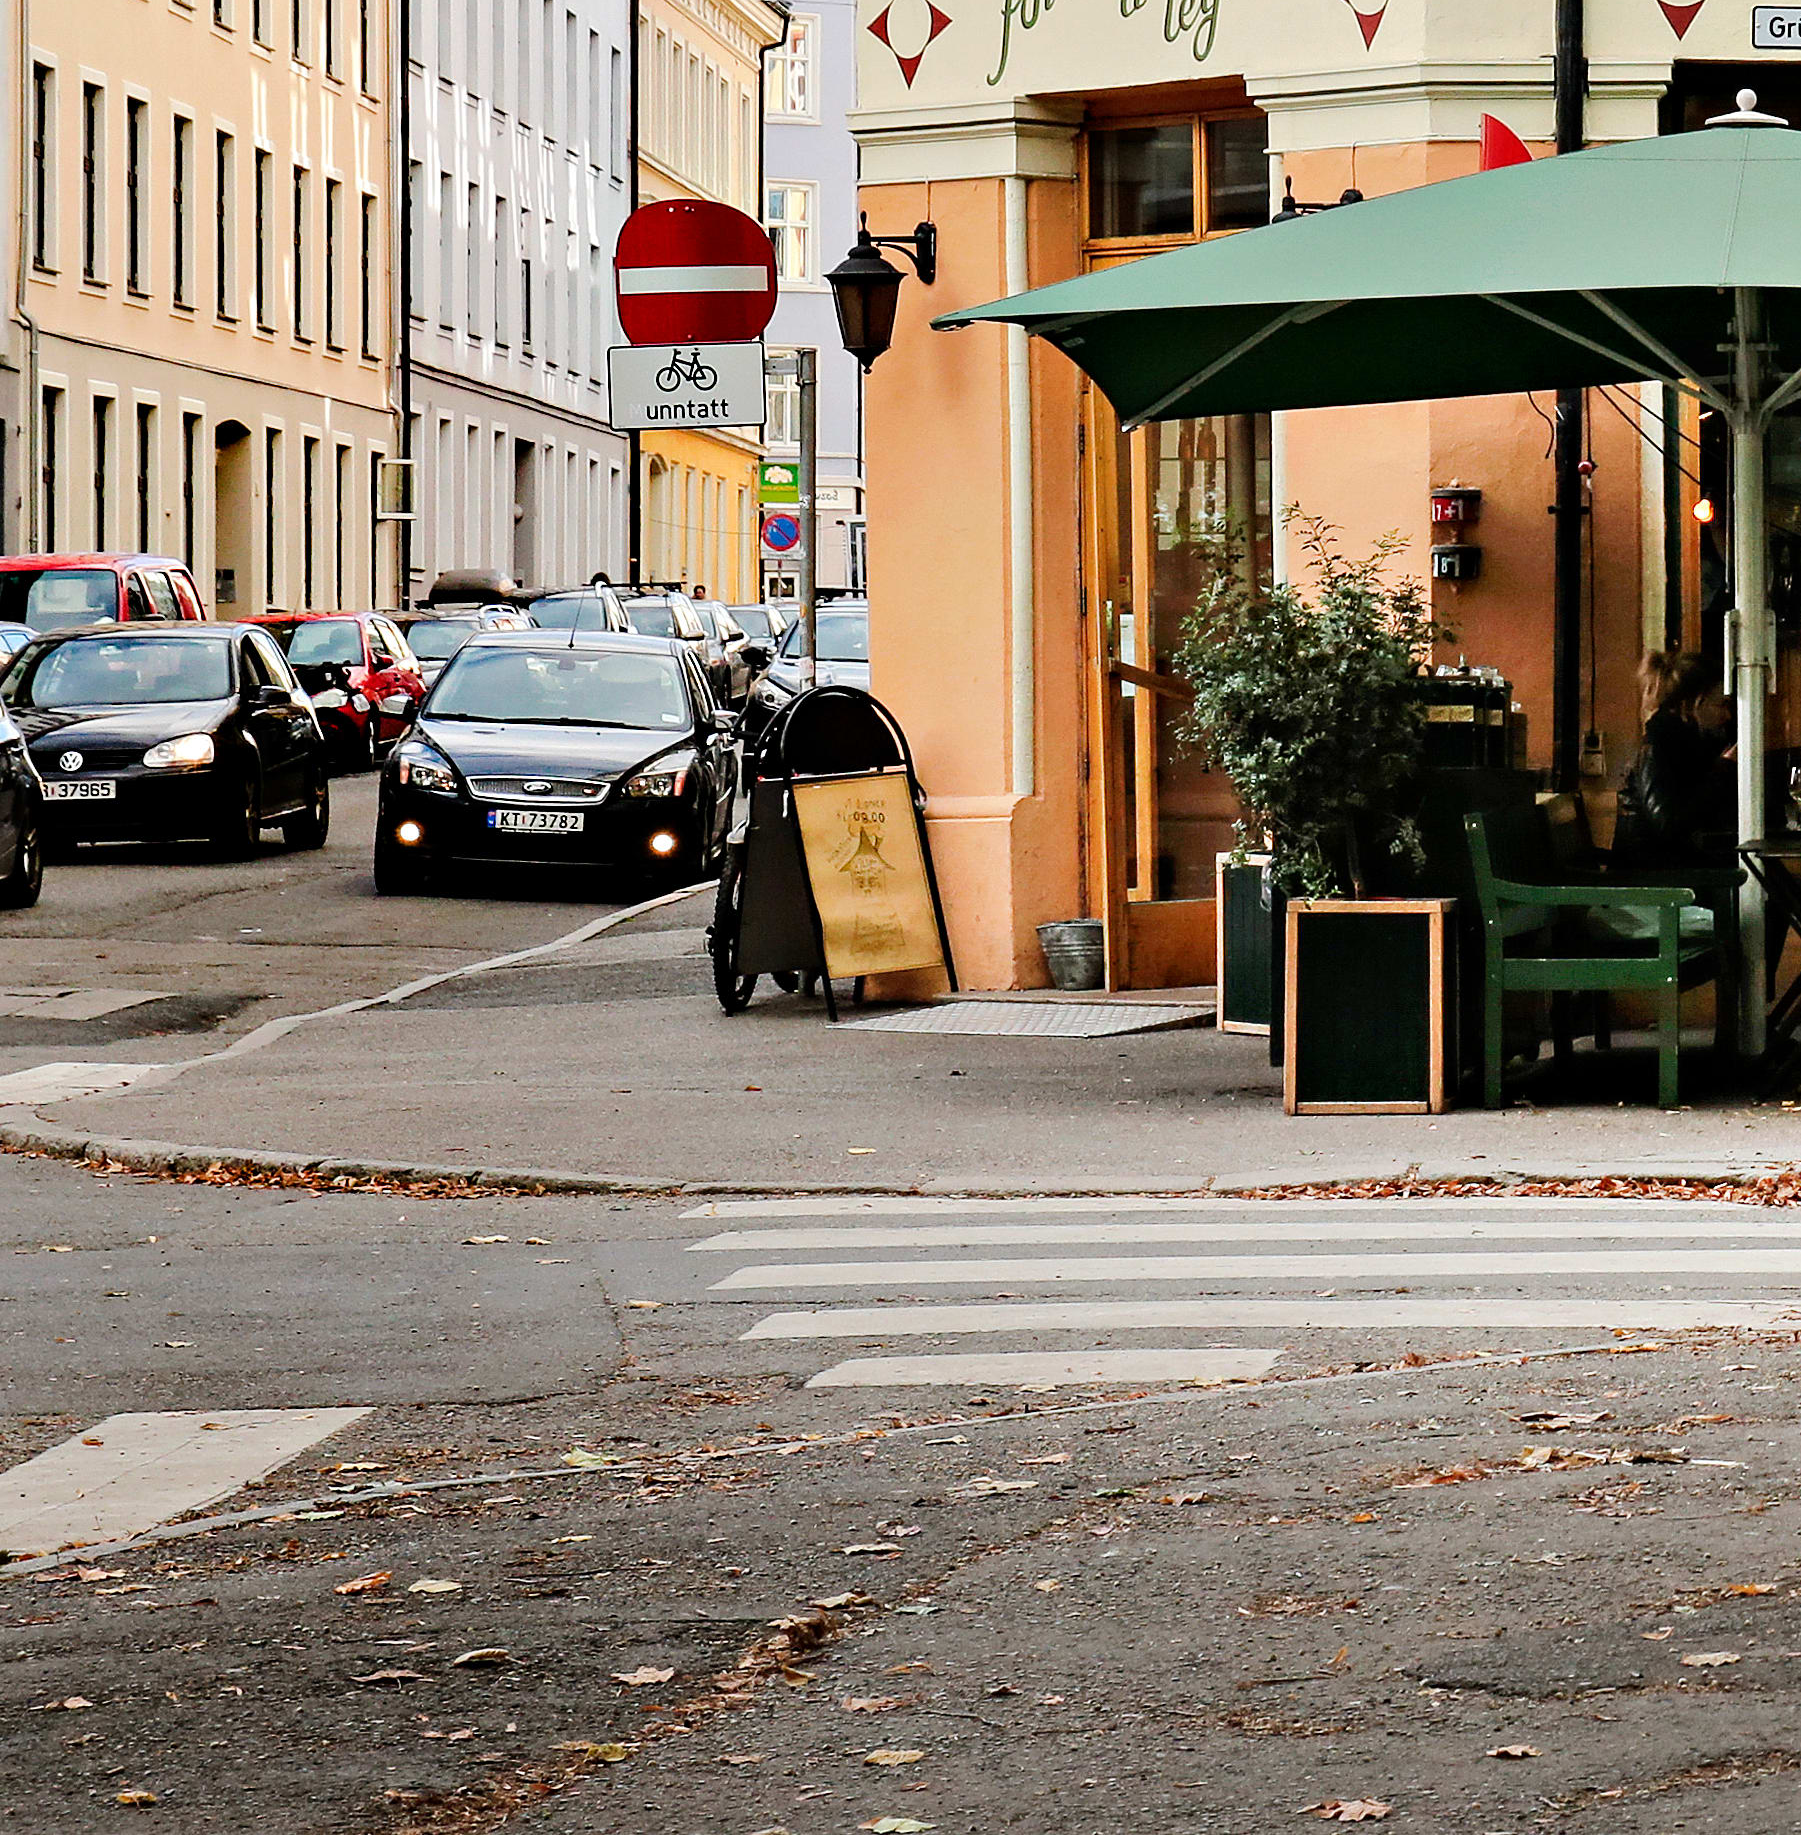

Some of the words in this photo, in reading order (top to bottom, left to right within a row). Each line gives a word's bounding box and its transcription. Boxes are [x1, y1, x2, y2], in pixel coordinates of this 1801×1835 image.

[646, 398, 729, 420] unntatt
[58, 782, 111, 798] 37965
[500, 812, 520, 827] KT
[529, 813, 579, 829] 73782
